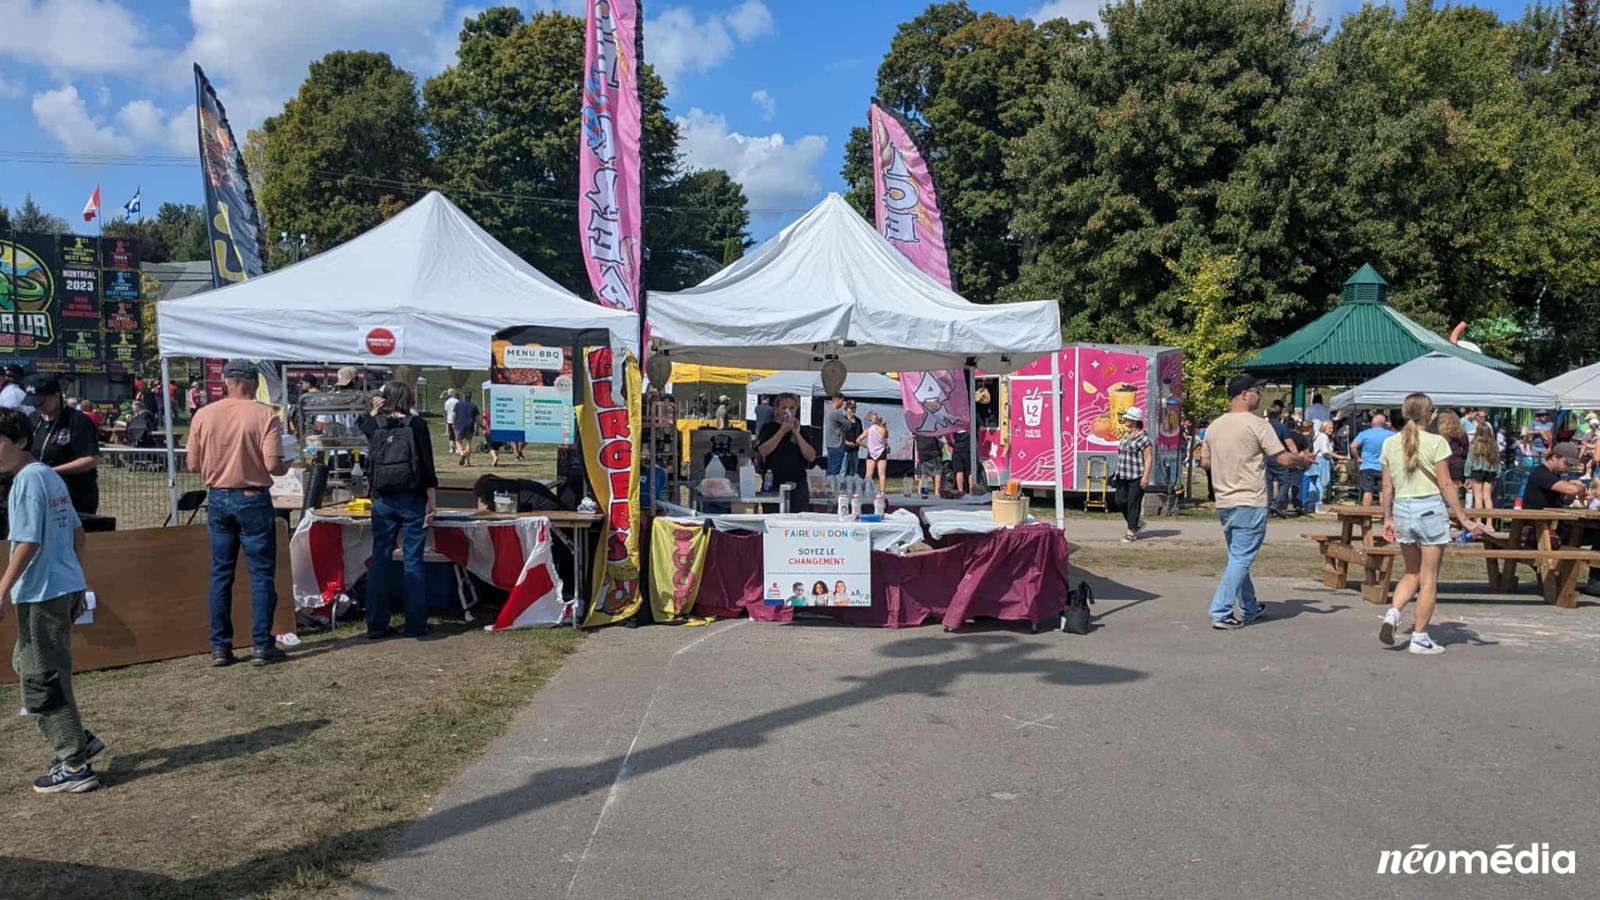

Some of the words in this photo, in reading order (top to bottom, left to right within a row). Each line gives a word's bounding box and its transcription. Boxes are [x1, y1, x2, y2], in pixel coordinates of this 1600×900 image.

[63, 270, 96, 279] MONTREAL
[66, 280, 94, 291] 2023
[0, 314, 49, 337] AUR
[507, 349, 535, 357] MENU
[539, 351, 560, 359] BBQ
[1026, 405, 1038, 417] L2
[588, 347, 633, 563] BURGERS
[784, 529, 810, 537] FAIRE
